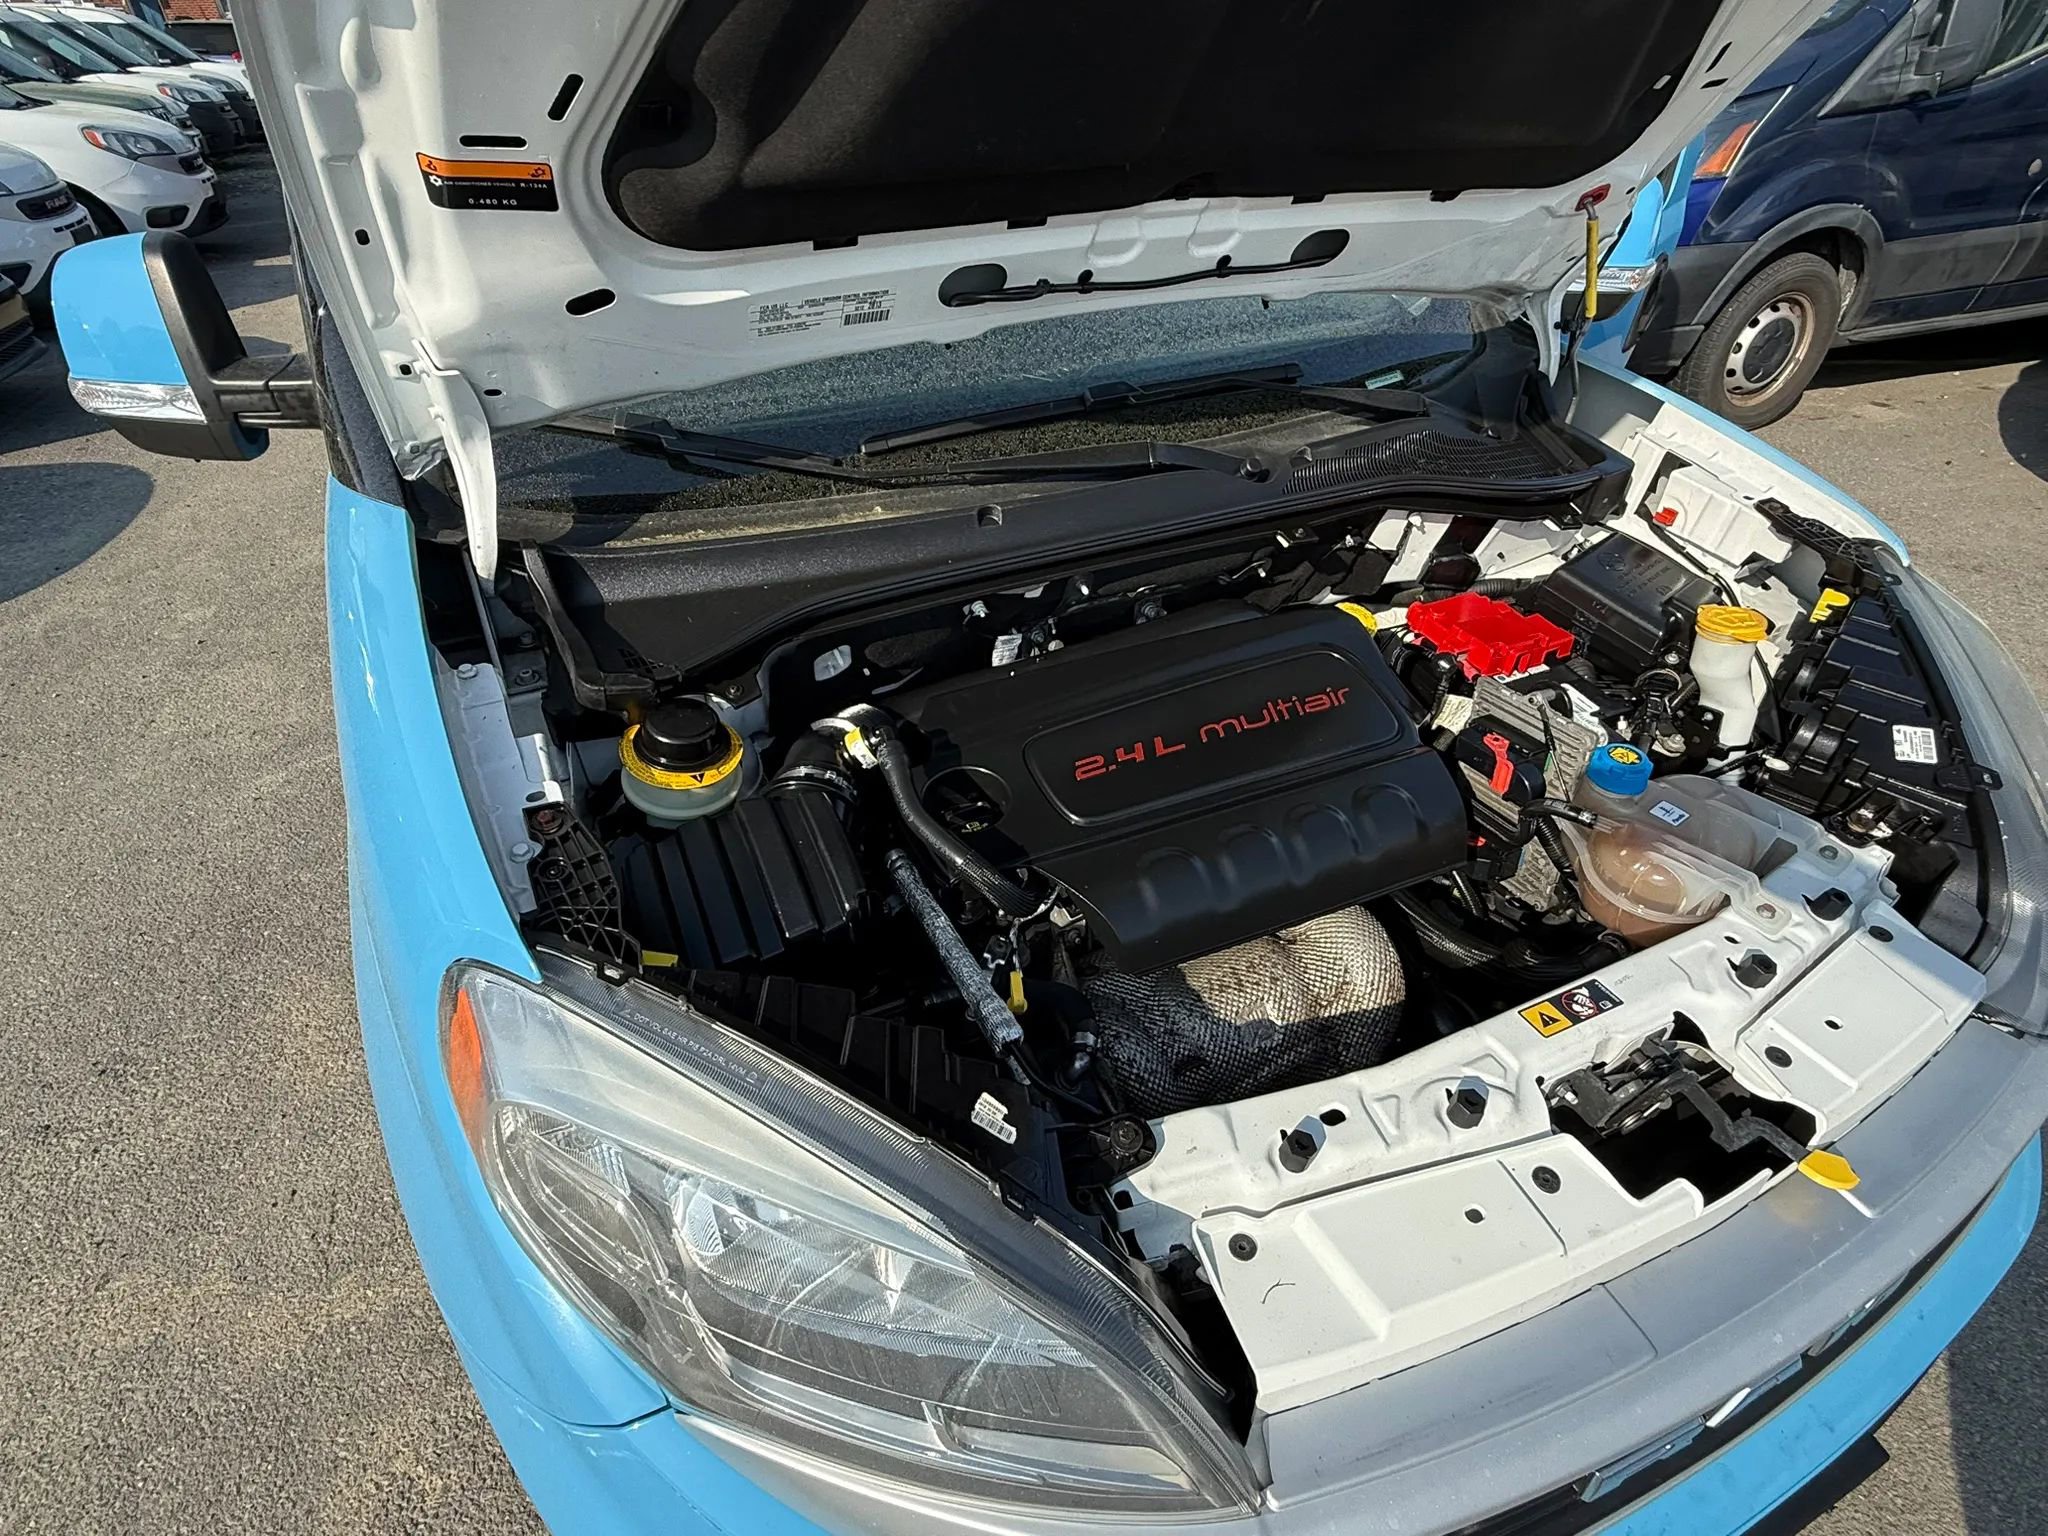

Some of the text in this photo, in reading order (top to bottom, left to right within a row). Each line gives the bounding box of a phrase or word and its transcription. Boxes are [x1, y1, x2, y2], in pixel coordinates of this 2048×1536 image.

[1074, 687, 1350, 782] 2.4 L multiair
[634, 1013, 649, 1024] DOT
[649, 1019, 661, 1031] VOL
[662, 1027, 677, 1039] SAE
